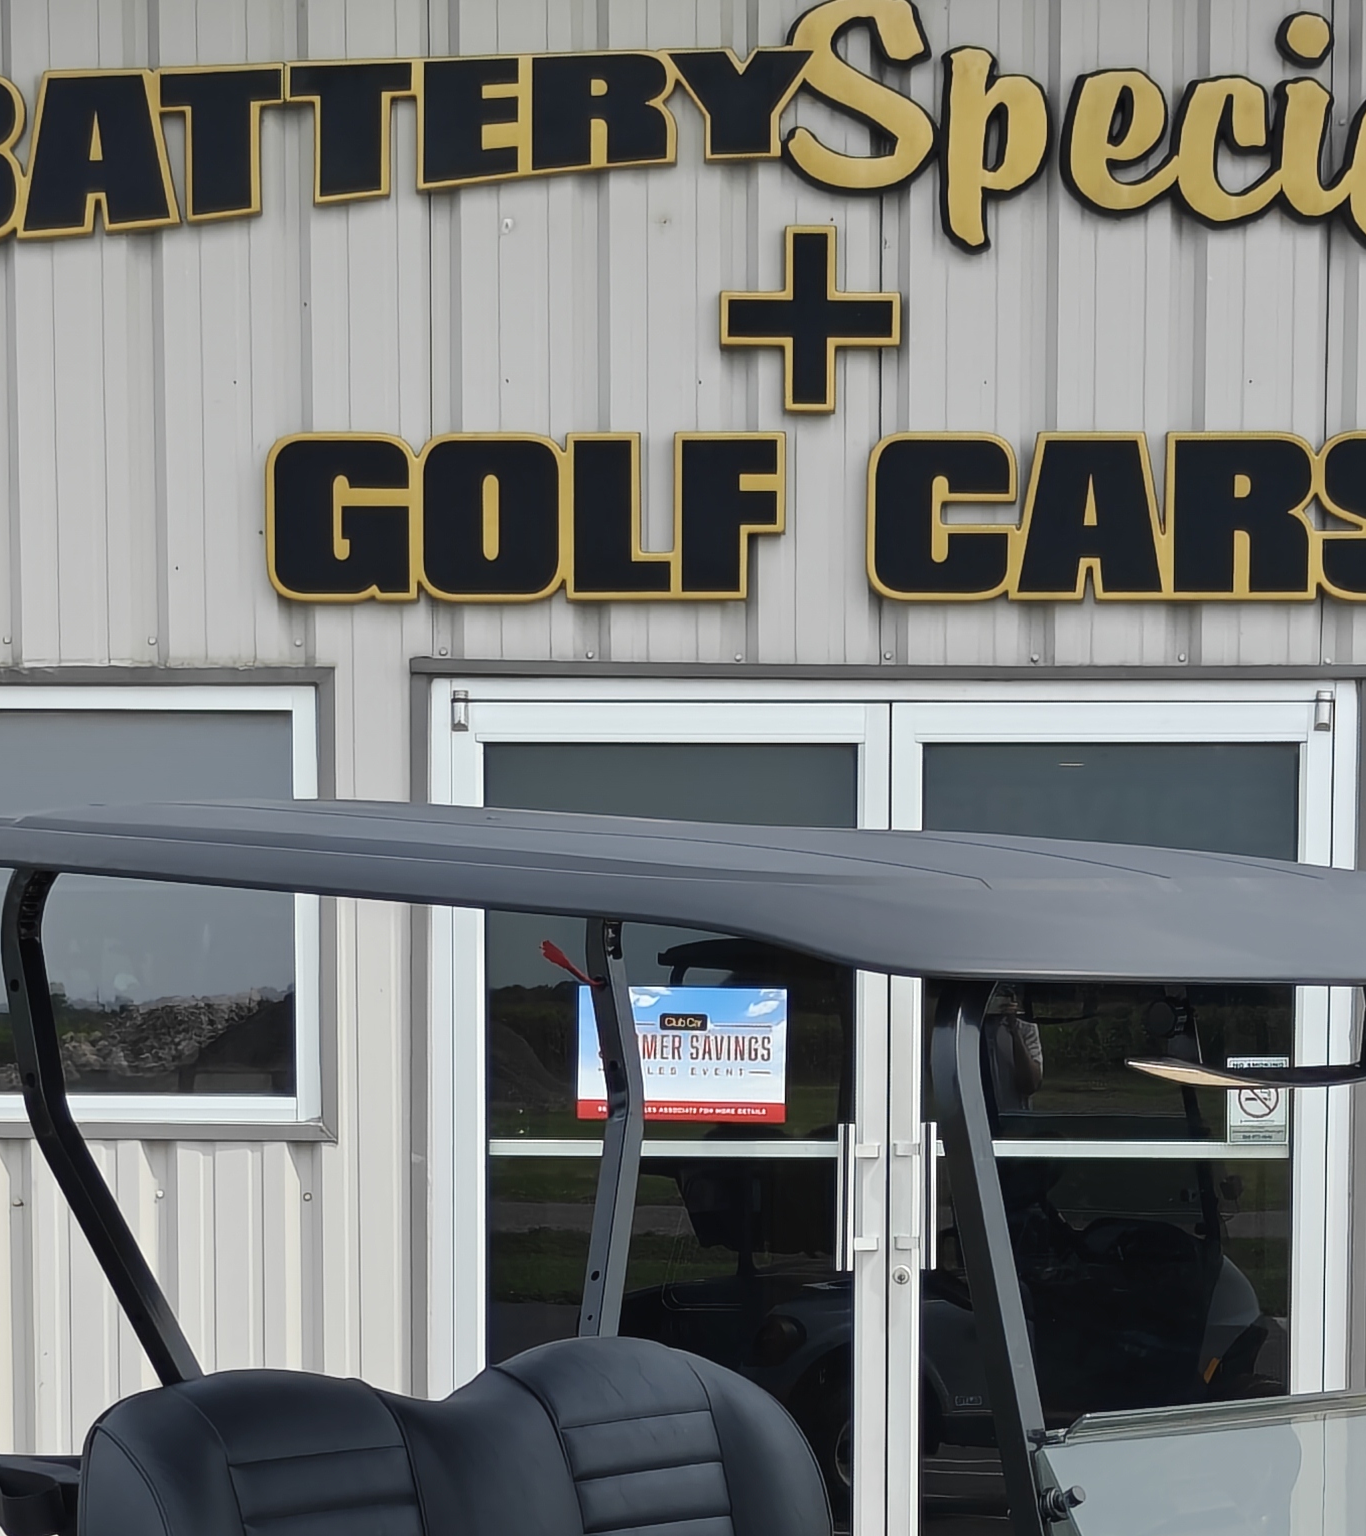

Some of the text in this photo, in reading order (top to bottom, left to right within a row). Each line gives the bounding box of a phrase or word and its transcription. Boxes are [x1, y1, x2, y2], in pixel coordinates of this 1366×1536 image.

[265, 431, 787, 602] GOLF
[690, 1034, 772, 1062] SAVINGS
[690, 1067, 745, 1077] EVENT
